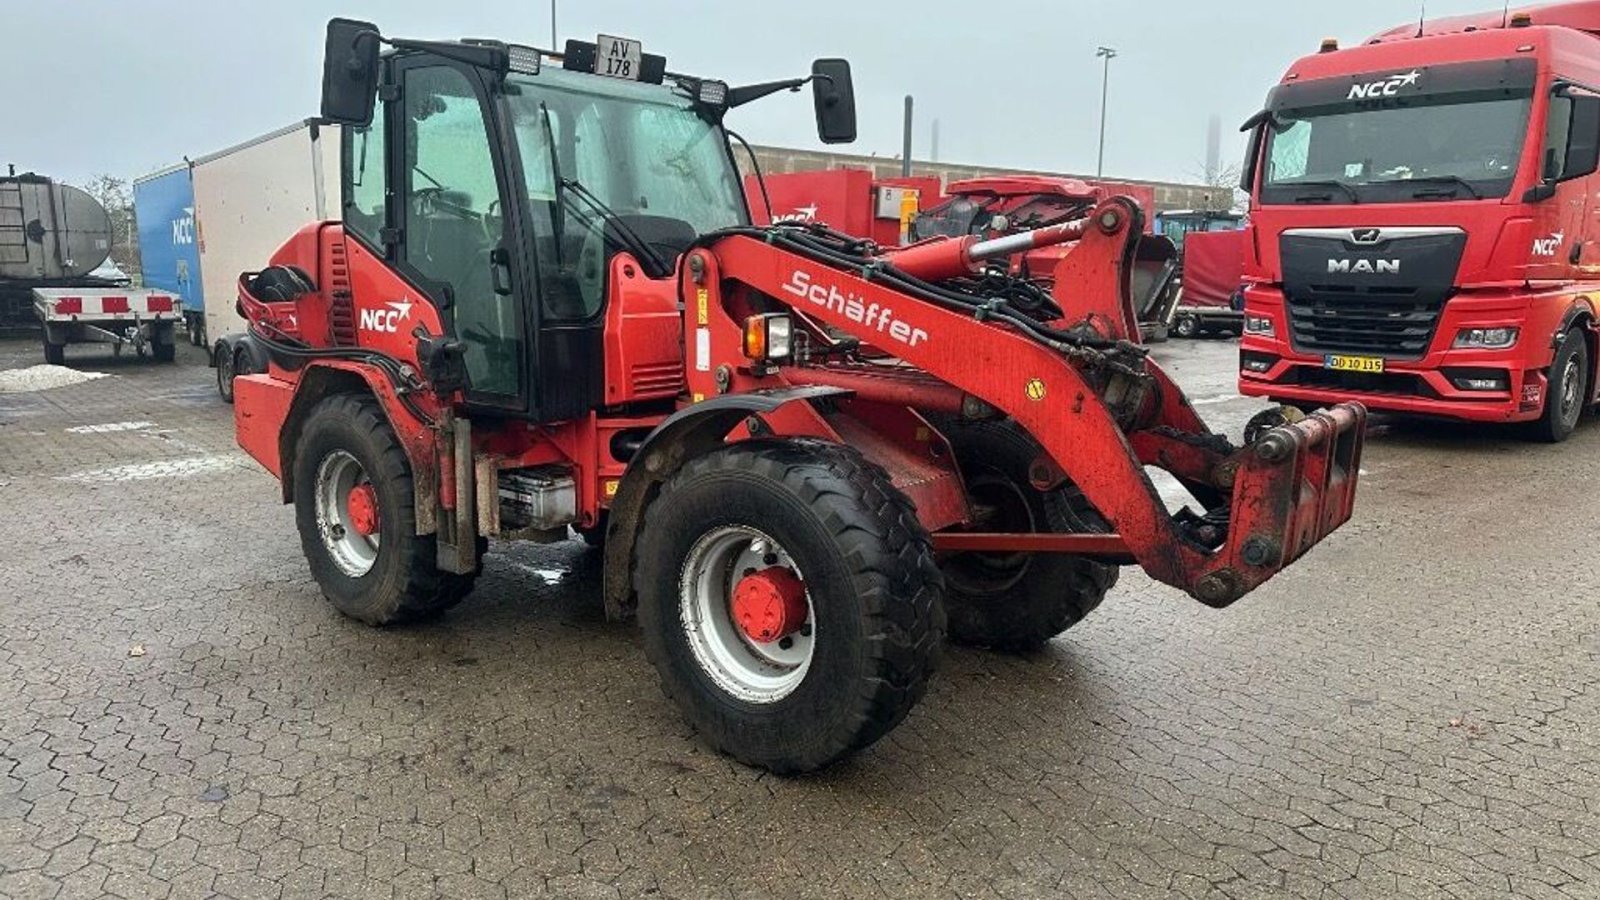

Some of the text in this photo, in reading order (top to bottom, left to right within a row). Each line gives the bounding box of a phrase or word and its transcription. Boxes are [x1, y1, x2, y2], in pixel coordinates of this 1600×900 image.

[610, 41, 630, 58] AV
[606, 58, 631, 76] 178
[1346, 79, 1401, 99] NCC
[1531, 239, 1556, 256] NCC
[1327, 258, 1401, 274] MAN
[782, 270, 930, 347] Schäffer
[359, 308, 398, 333] NCC
[1331, 357, 1381, 370] DD 10 115
